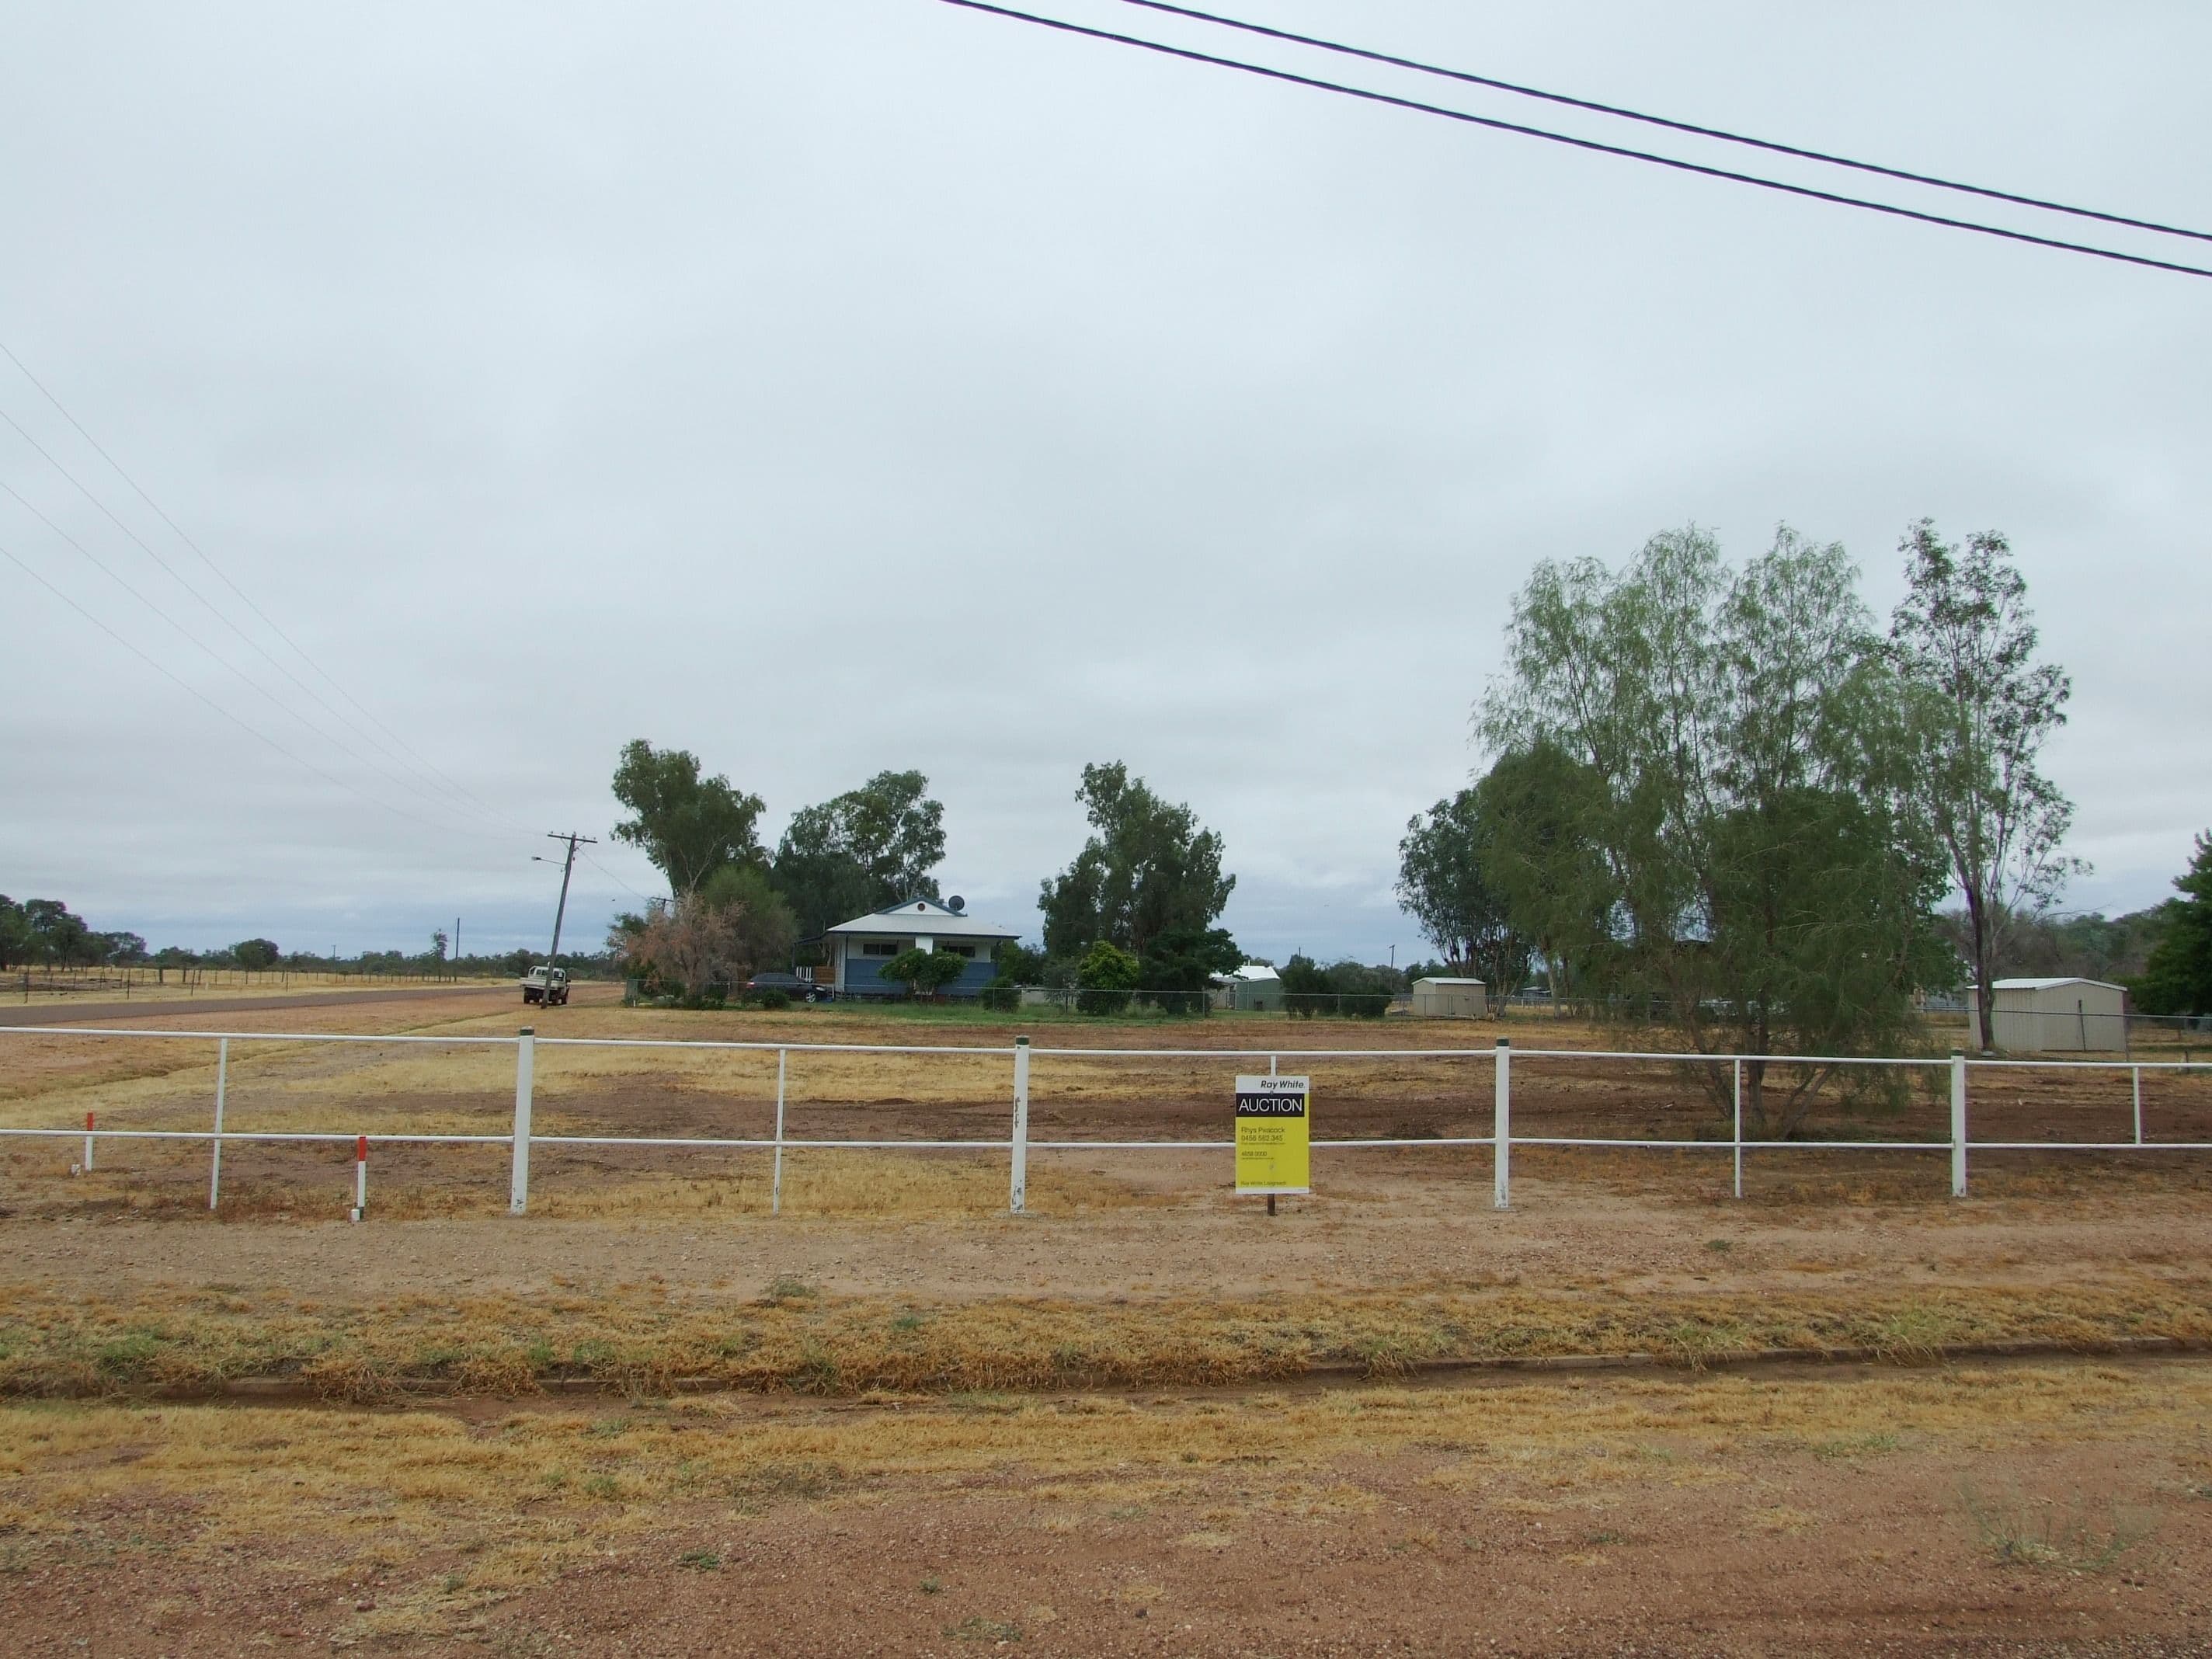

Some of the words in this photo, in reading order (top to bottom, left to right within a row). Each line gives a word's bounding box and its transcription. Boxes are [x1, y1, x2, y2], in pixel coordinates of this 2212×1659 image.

[1261, 1080, 1278, 1089] Ray
[1279, 1080, 1304, 1088] White
[1239, 1098, 1303, 1112] AUCTION
